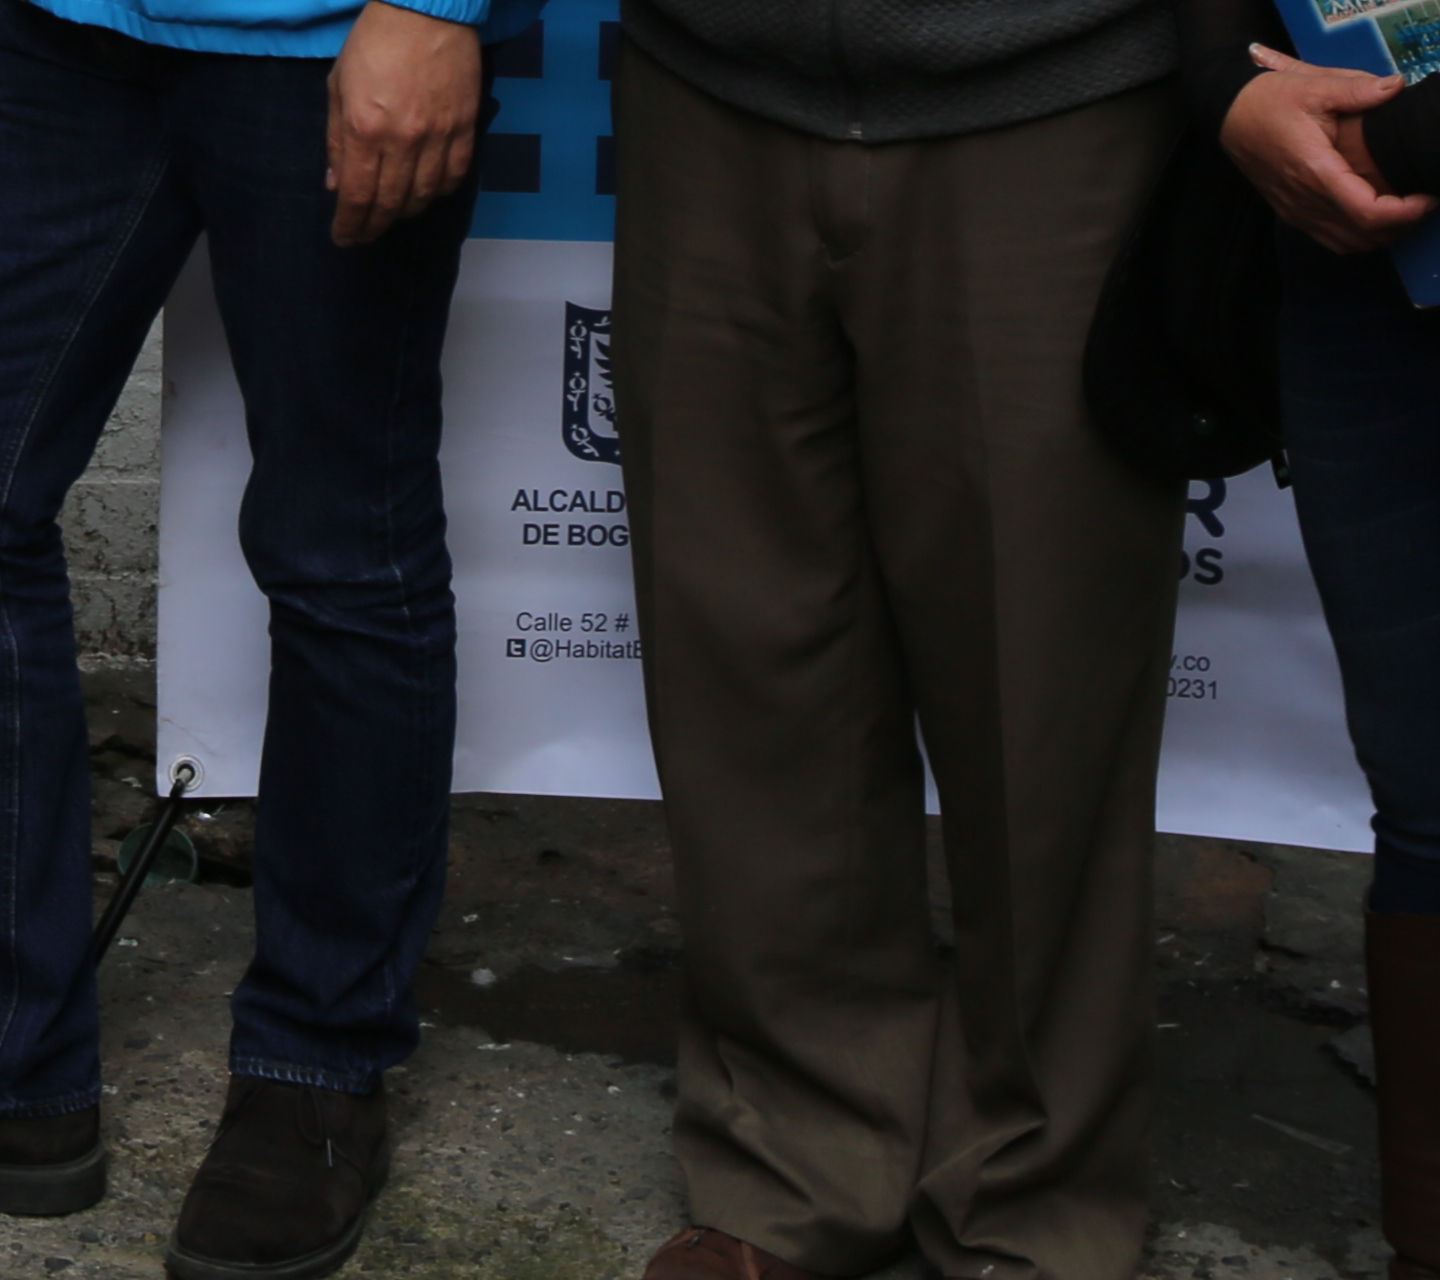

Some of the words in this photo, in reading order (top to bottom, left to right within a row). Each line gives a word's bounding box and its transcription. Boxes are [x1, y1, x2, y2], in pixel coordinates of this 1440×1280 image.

[511, 488, 627, 513] ALCALD
[522, 523, 560, 546] DE
[567, 523, 630, 547] BOG
[516, 611, 573, 632] Calle
[580, 613, 608, 632] 52
[615, 613, 630, 632] #
